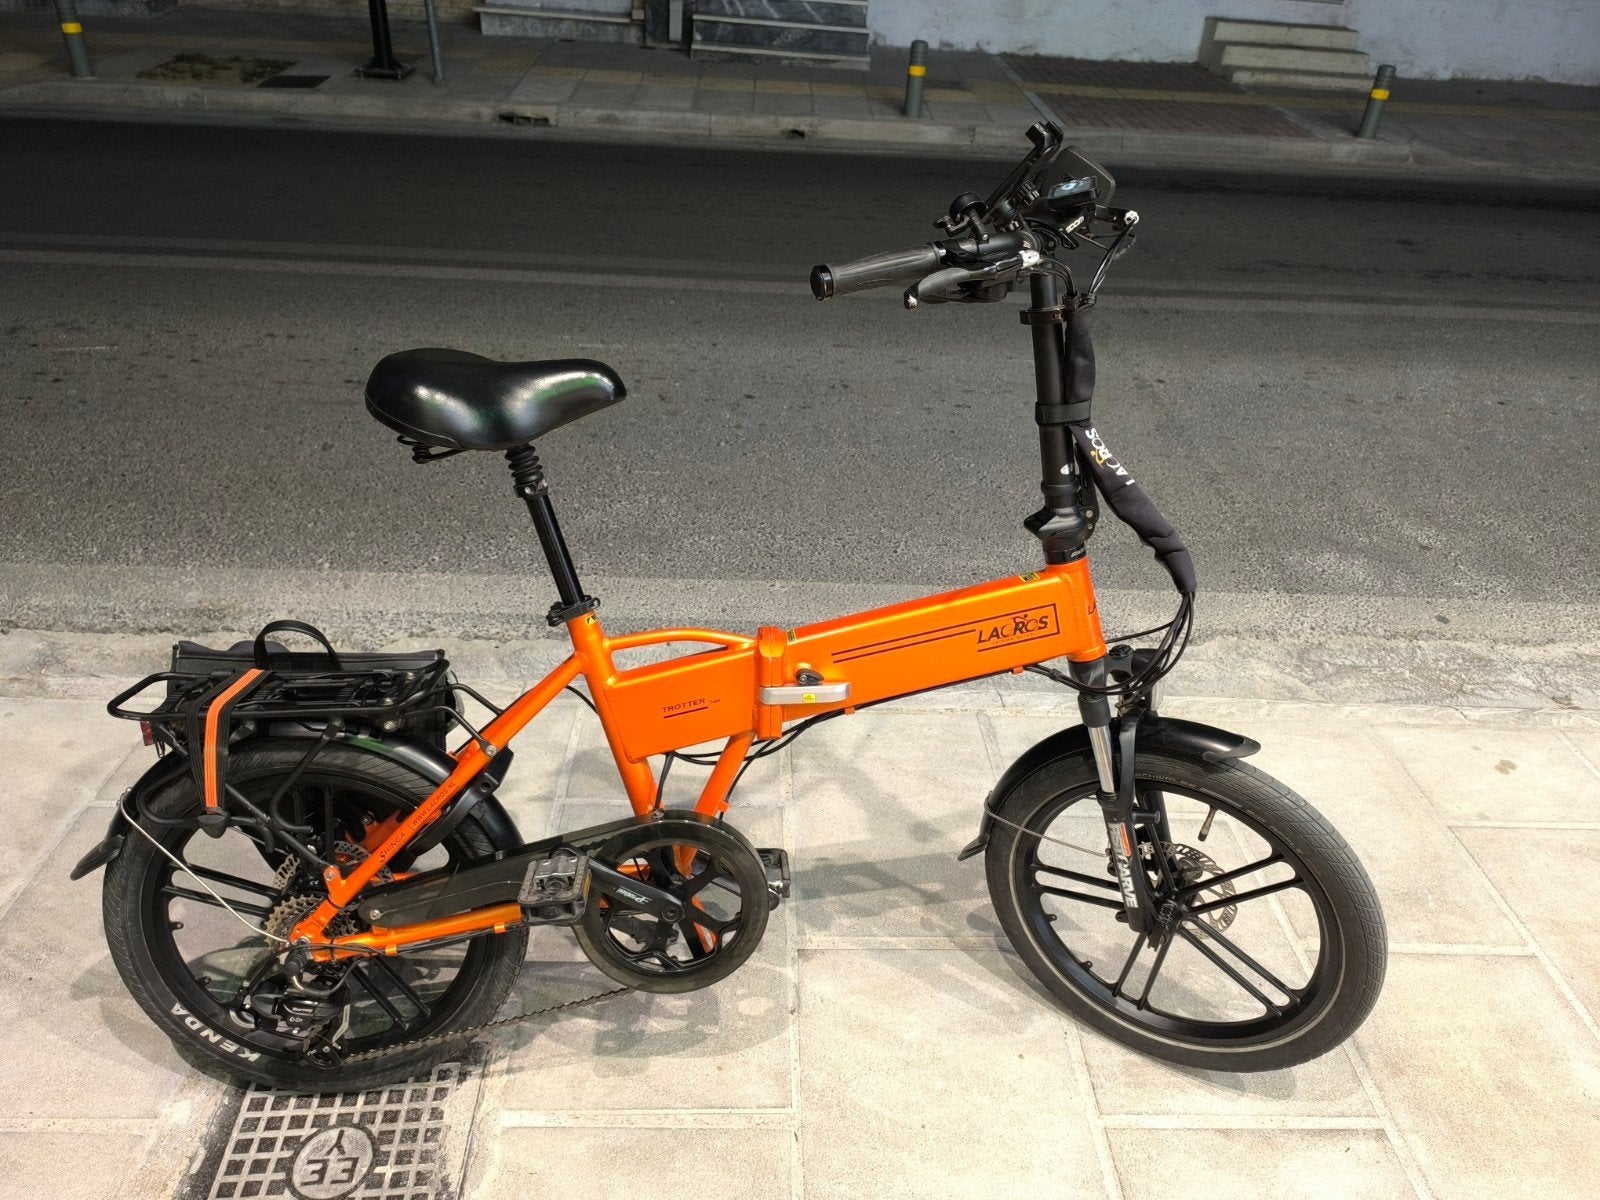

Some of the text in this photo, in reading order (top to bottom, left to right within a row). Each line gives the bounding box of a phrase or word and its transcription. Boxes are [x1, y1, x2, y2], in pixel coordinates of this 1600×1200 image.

[976, 614, 1049, 645] LACROS
[661, 697, 706, 713] TROTTER
[379, 832, 406, 863] SHINGA
[170, 1002, 263, 1063] KENDA
